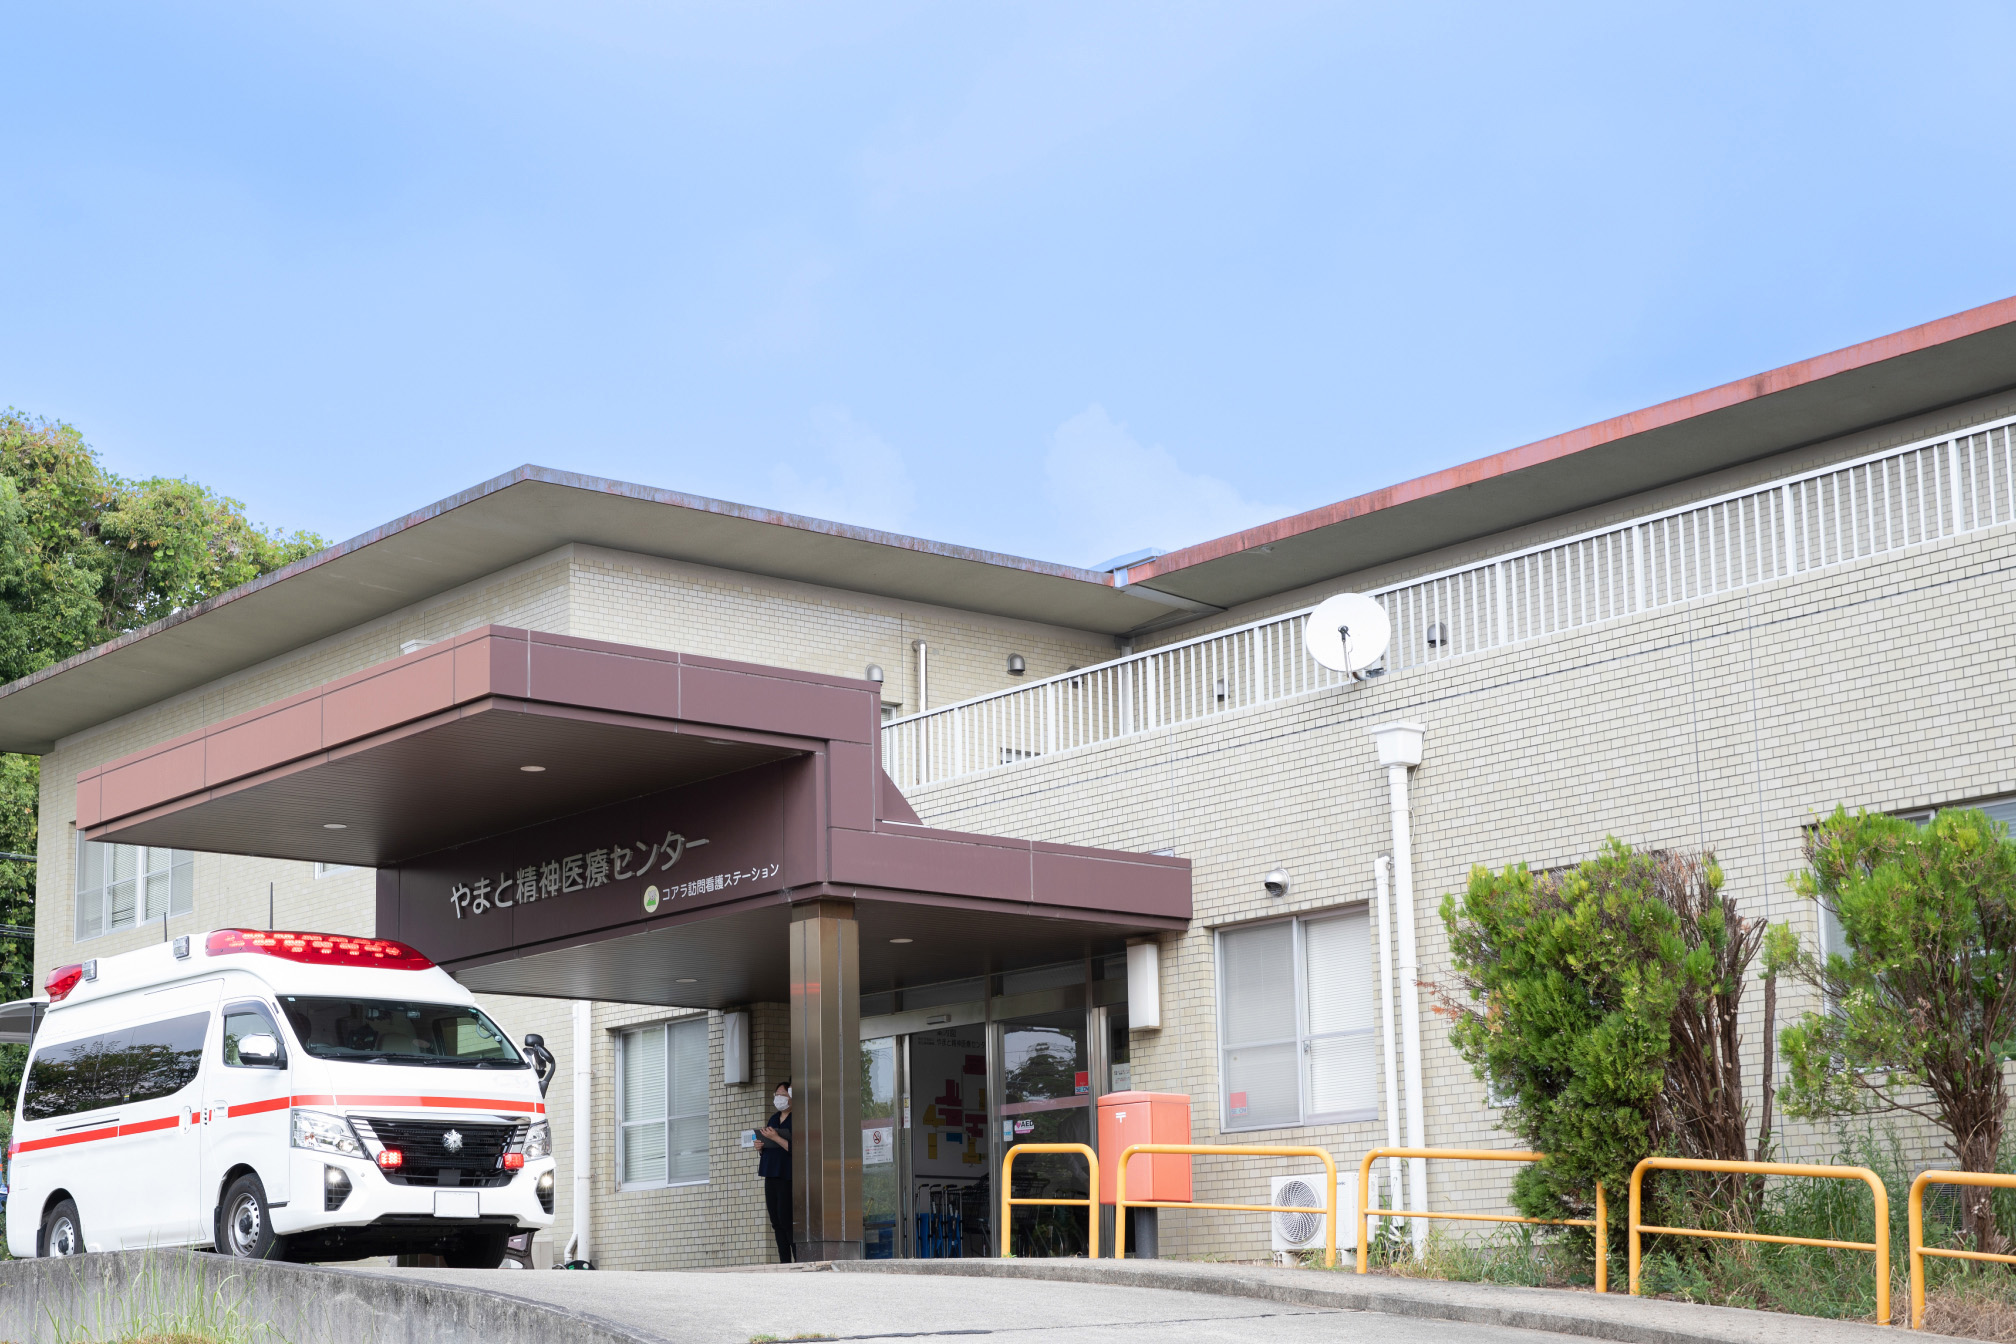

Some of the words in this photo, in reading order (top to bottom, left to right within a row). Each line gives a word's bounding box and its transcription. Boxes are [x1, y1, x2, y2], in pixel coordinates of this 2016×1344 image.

[450, 831, 709, 919] やまと精神医療センター
[662, 863, 779, 901] コアラ訪問看護ステーション
[937, 1038, 985, 1049] やまと精神医療センタ
